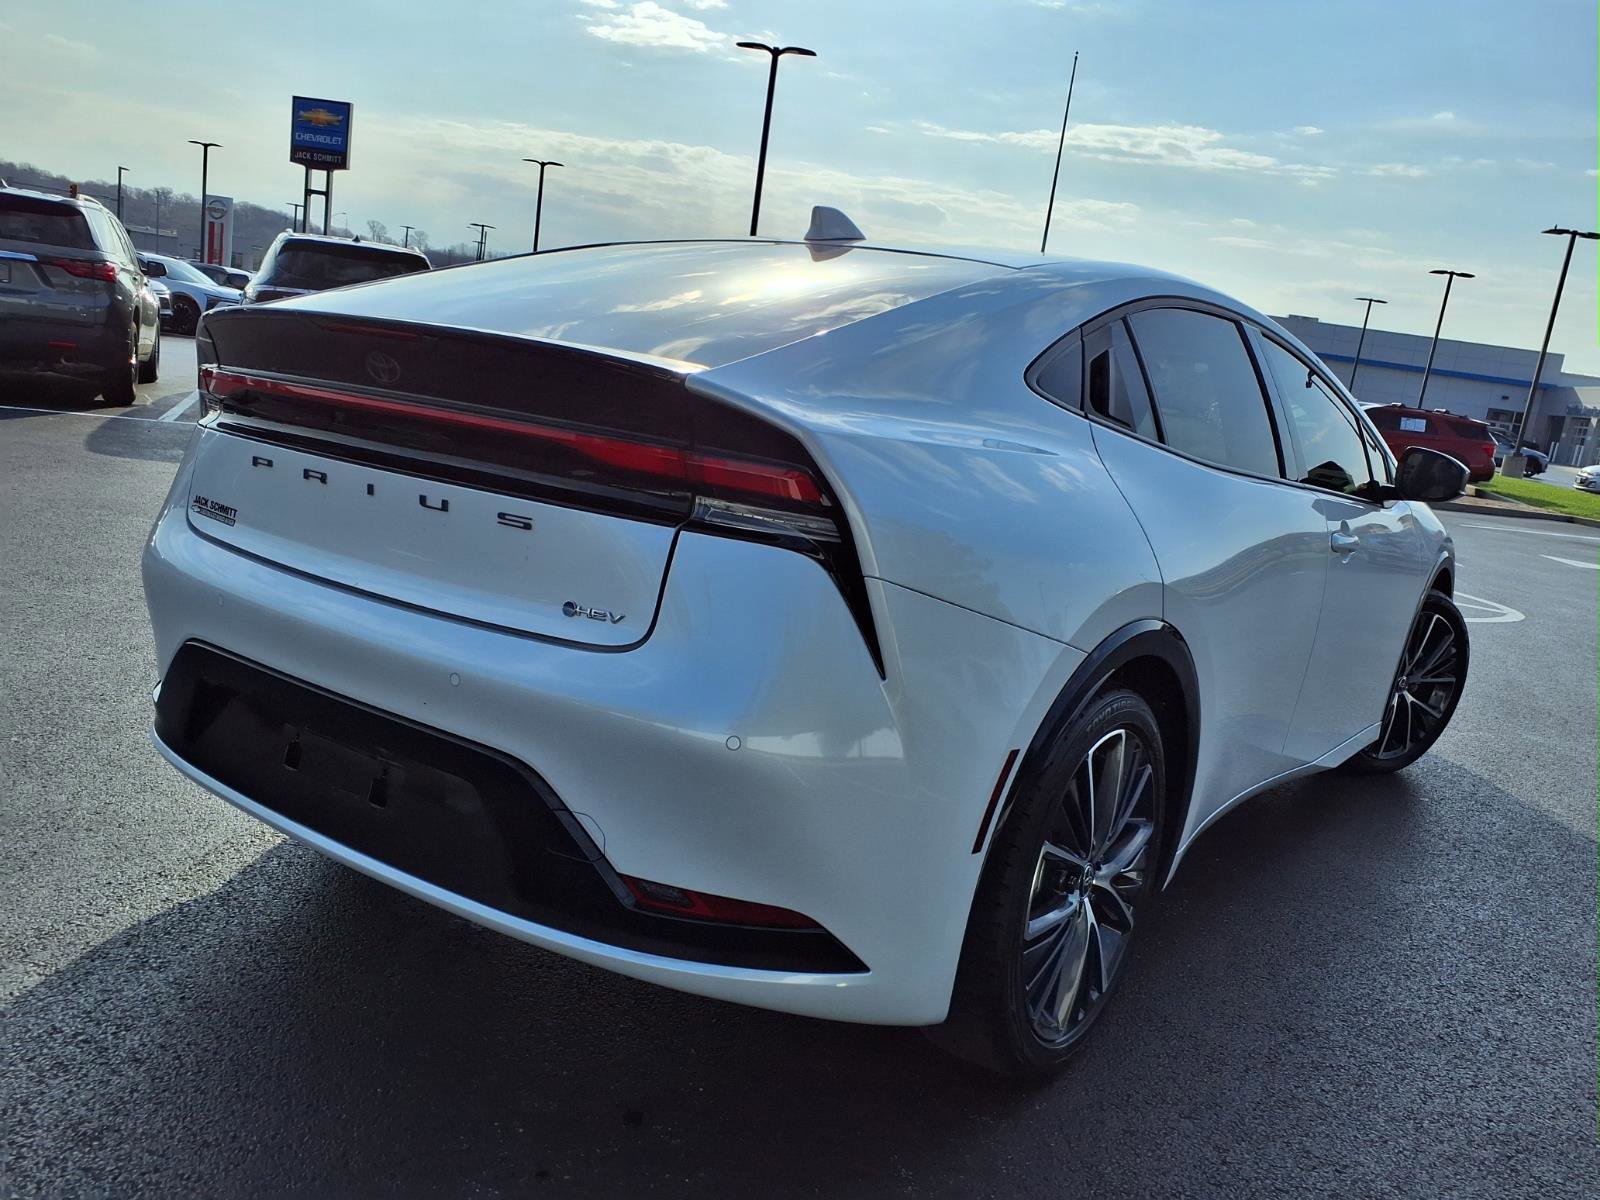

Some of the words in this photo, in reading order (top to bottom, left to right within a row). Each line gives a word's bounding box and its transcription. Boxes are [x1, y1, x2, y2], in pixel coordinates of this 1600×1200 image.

[295, 132, 342, 145] CHEVROLET
[295, 151, 311, 160] JACK
[313, 153, 342, 163] SCHMITT
[252, 455, 532, 531] PRIUS
[193, 495, 209, 508] JACK
[209, 500, 238, 519] SCHMITT
[575, 605, 626, 625] HEV
